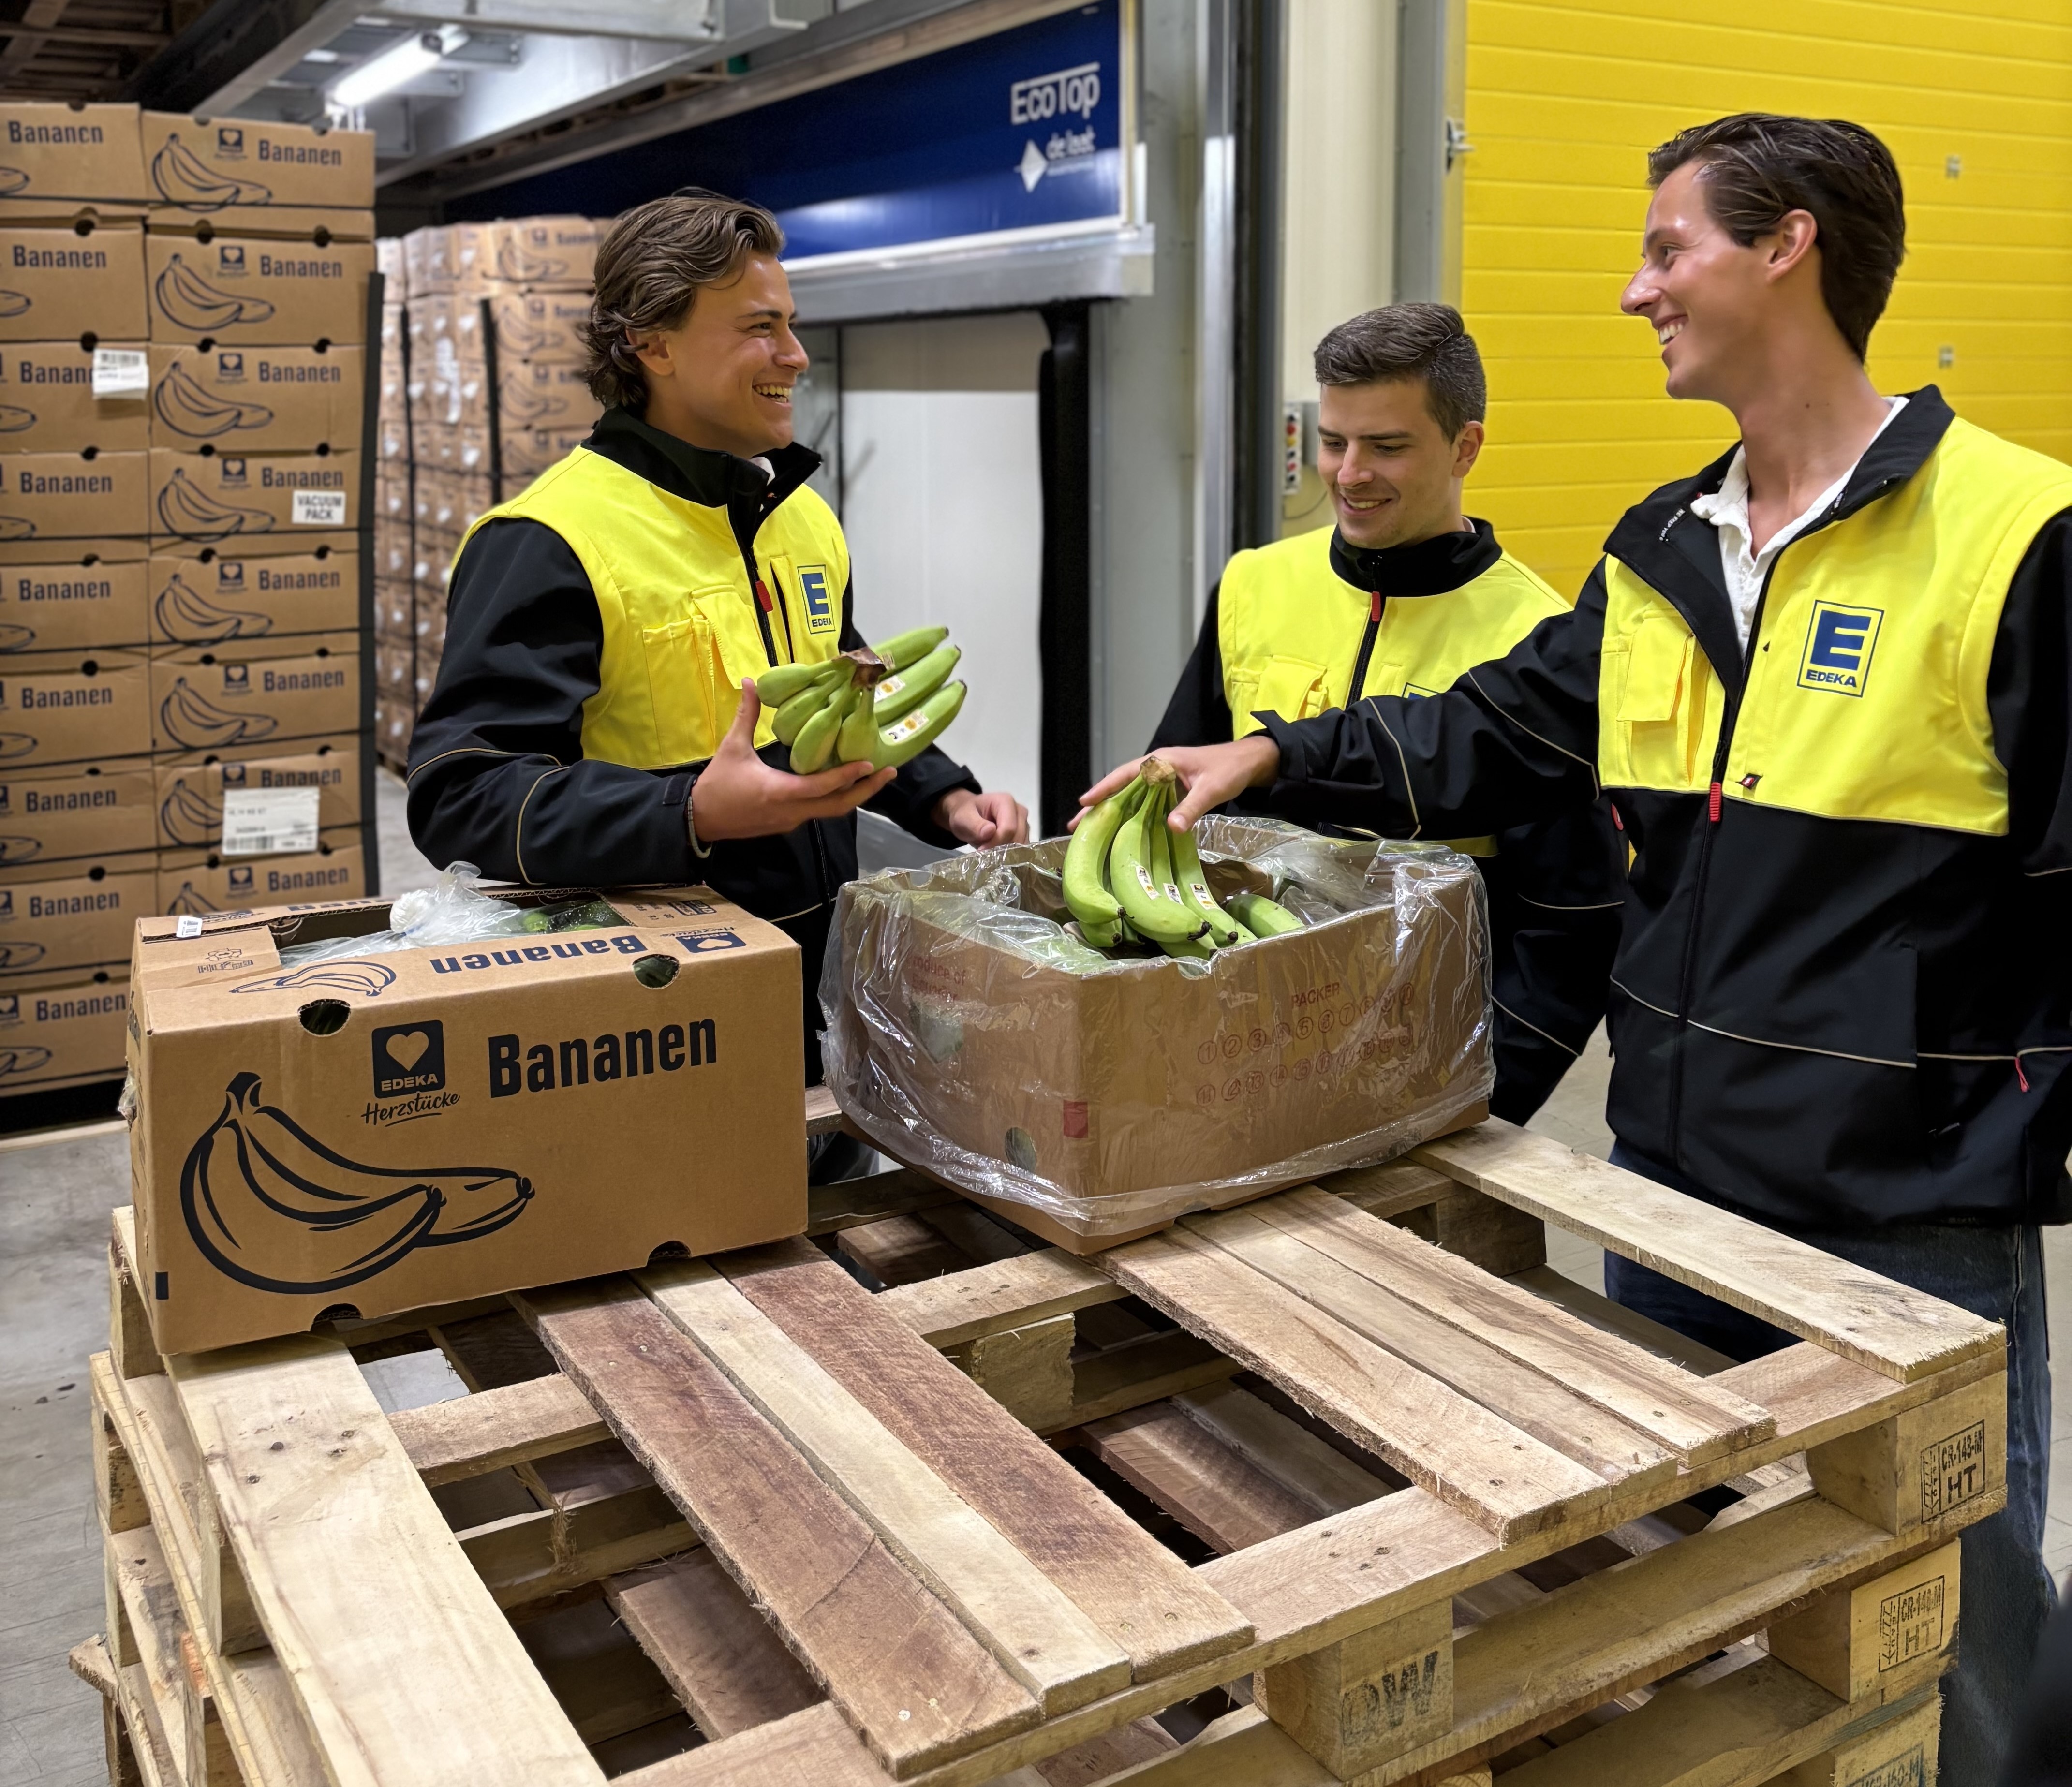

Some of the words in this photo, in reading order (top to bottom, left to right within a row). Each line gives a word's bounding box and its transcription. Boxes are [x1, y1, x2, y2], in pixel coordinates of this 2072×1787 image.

[1011, 62, 1100, 125] EcoTop
[9, 121, 103, 144] Bananen
[259, 140, 342, 166] Bananen
[13, 246, 106, 268] Bananen
[260, 255, 342, 278] Bananen
[20, 361, 92, 384] Banan
[259, 362, 340, 383] Bananen
[20, 473, 112, 494] Bananen
[262, 467, 343, 488] Bananen
[297, 495, 341, 507] VACUUM
[306, 508, 333, 520] PACK
[19, 580, 111, 601] Bananen
[259, 570, 340, 591] Bananen
[1810, 610, 1871, 671] E
[264, 670, 344, 692] Bananen
[1806, 669, 1857, 687] EDEKA
[22, 687, 112, 709] Bananen
[26, 789, 117, 812] Bananen
[268, 867, 349, 892] Bananen
[30, 892, 119, 917] Bananen
[430, 934, 648, 974] Bananen
[904, 954, 950, 979] roduce
[1291, 982, 1340, 1006] PACKER
[36, 993, 126, 1021] Bananen
[488, 1018, 717, 1098] Bananen
[381, 1073, 438, 1091] EDEKA
[360, 1091, 460, 1125] Herzstücke
[1948, 1463, 1976, 1503] HT
[1905, 1617, 1934, 1655] HT
